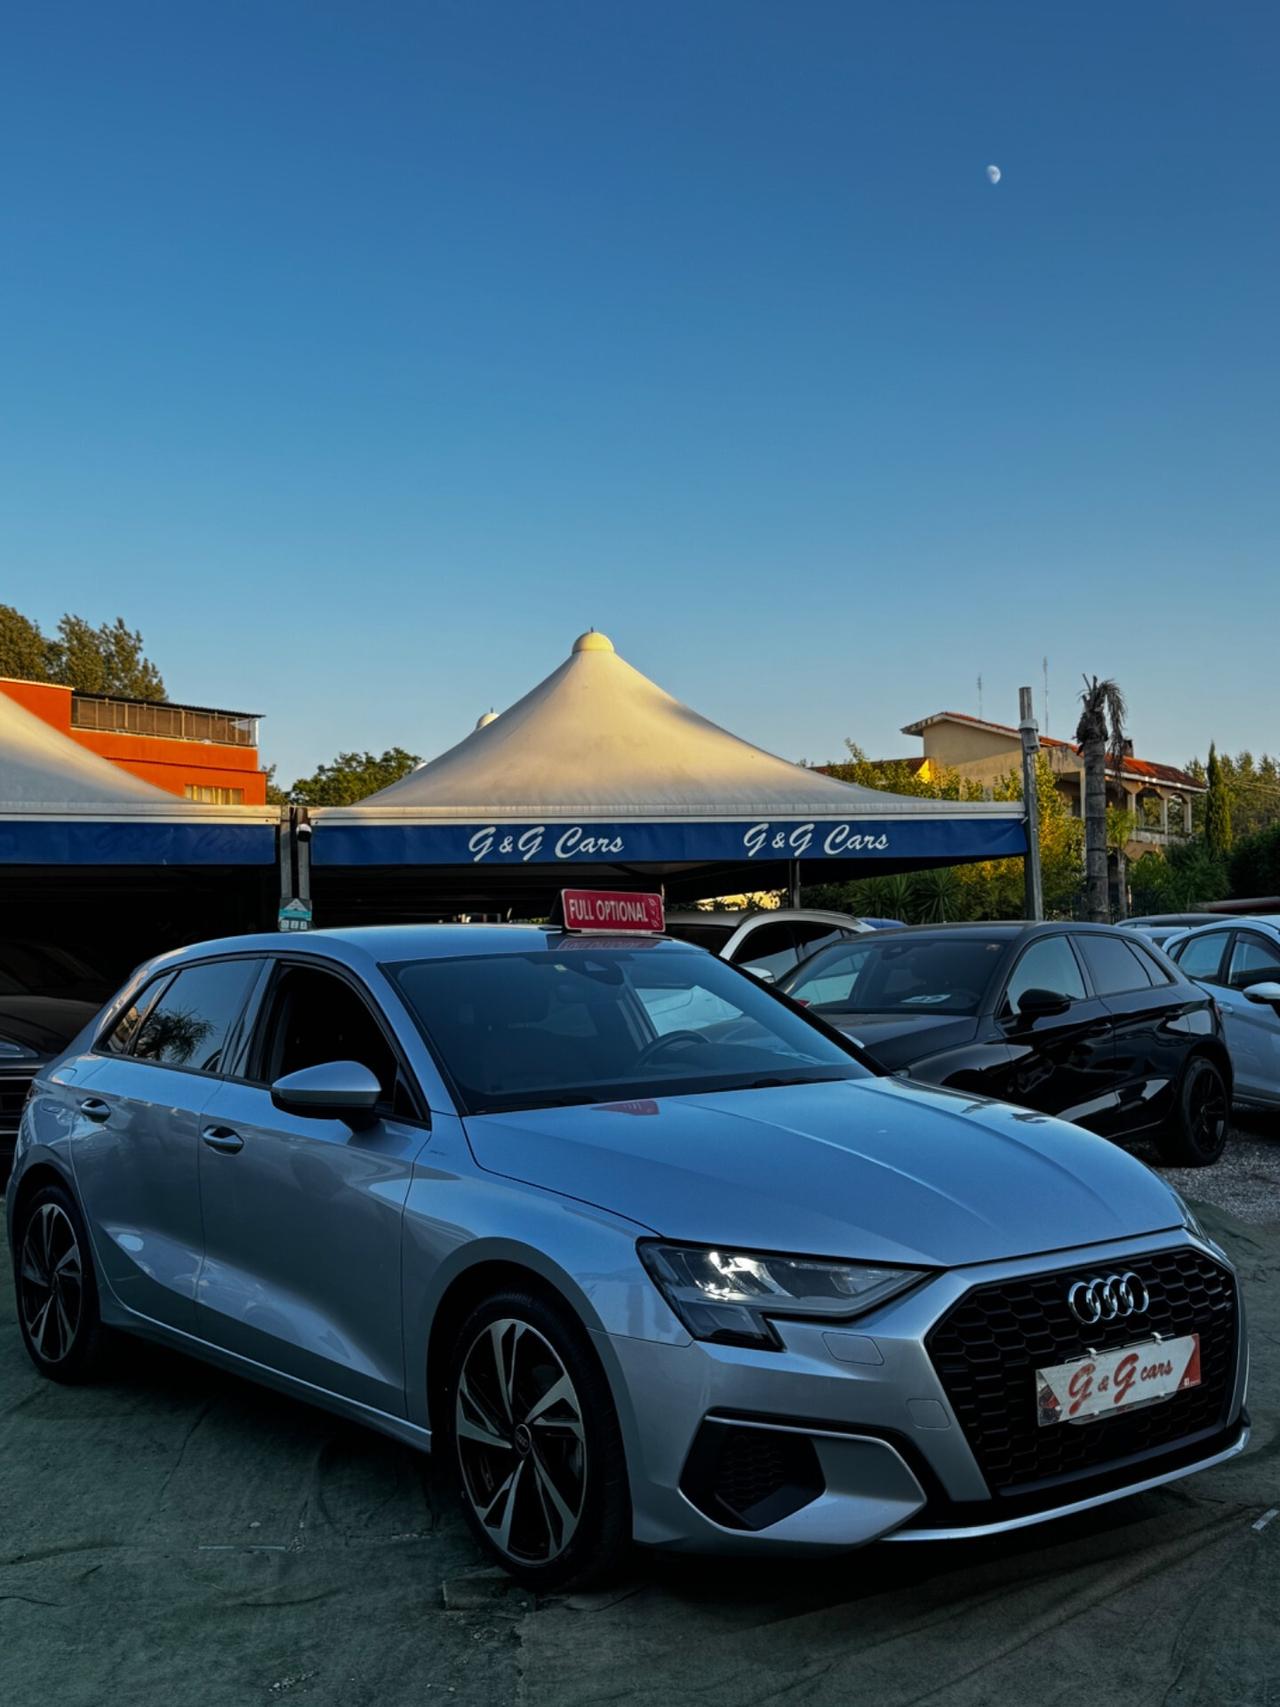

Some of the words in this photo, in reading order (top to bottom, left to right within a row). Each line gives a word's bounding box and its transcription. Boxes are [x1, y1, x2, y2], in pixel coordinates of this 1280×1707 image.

[555, 827, 625, 858] Cars
[824, 825, 889, 855] Cars
[569, 899, 594, 920] FULL
[596, 900, 648, 922] OPTIONAL
[1140, 1360, 1173, 1381] cars
